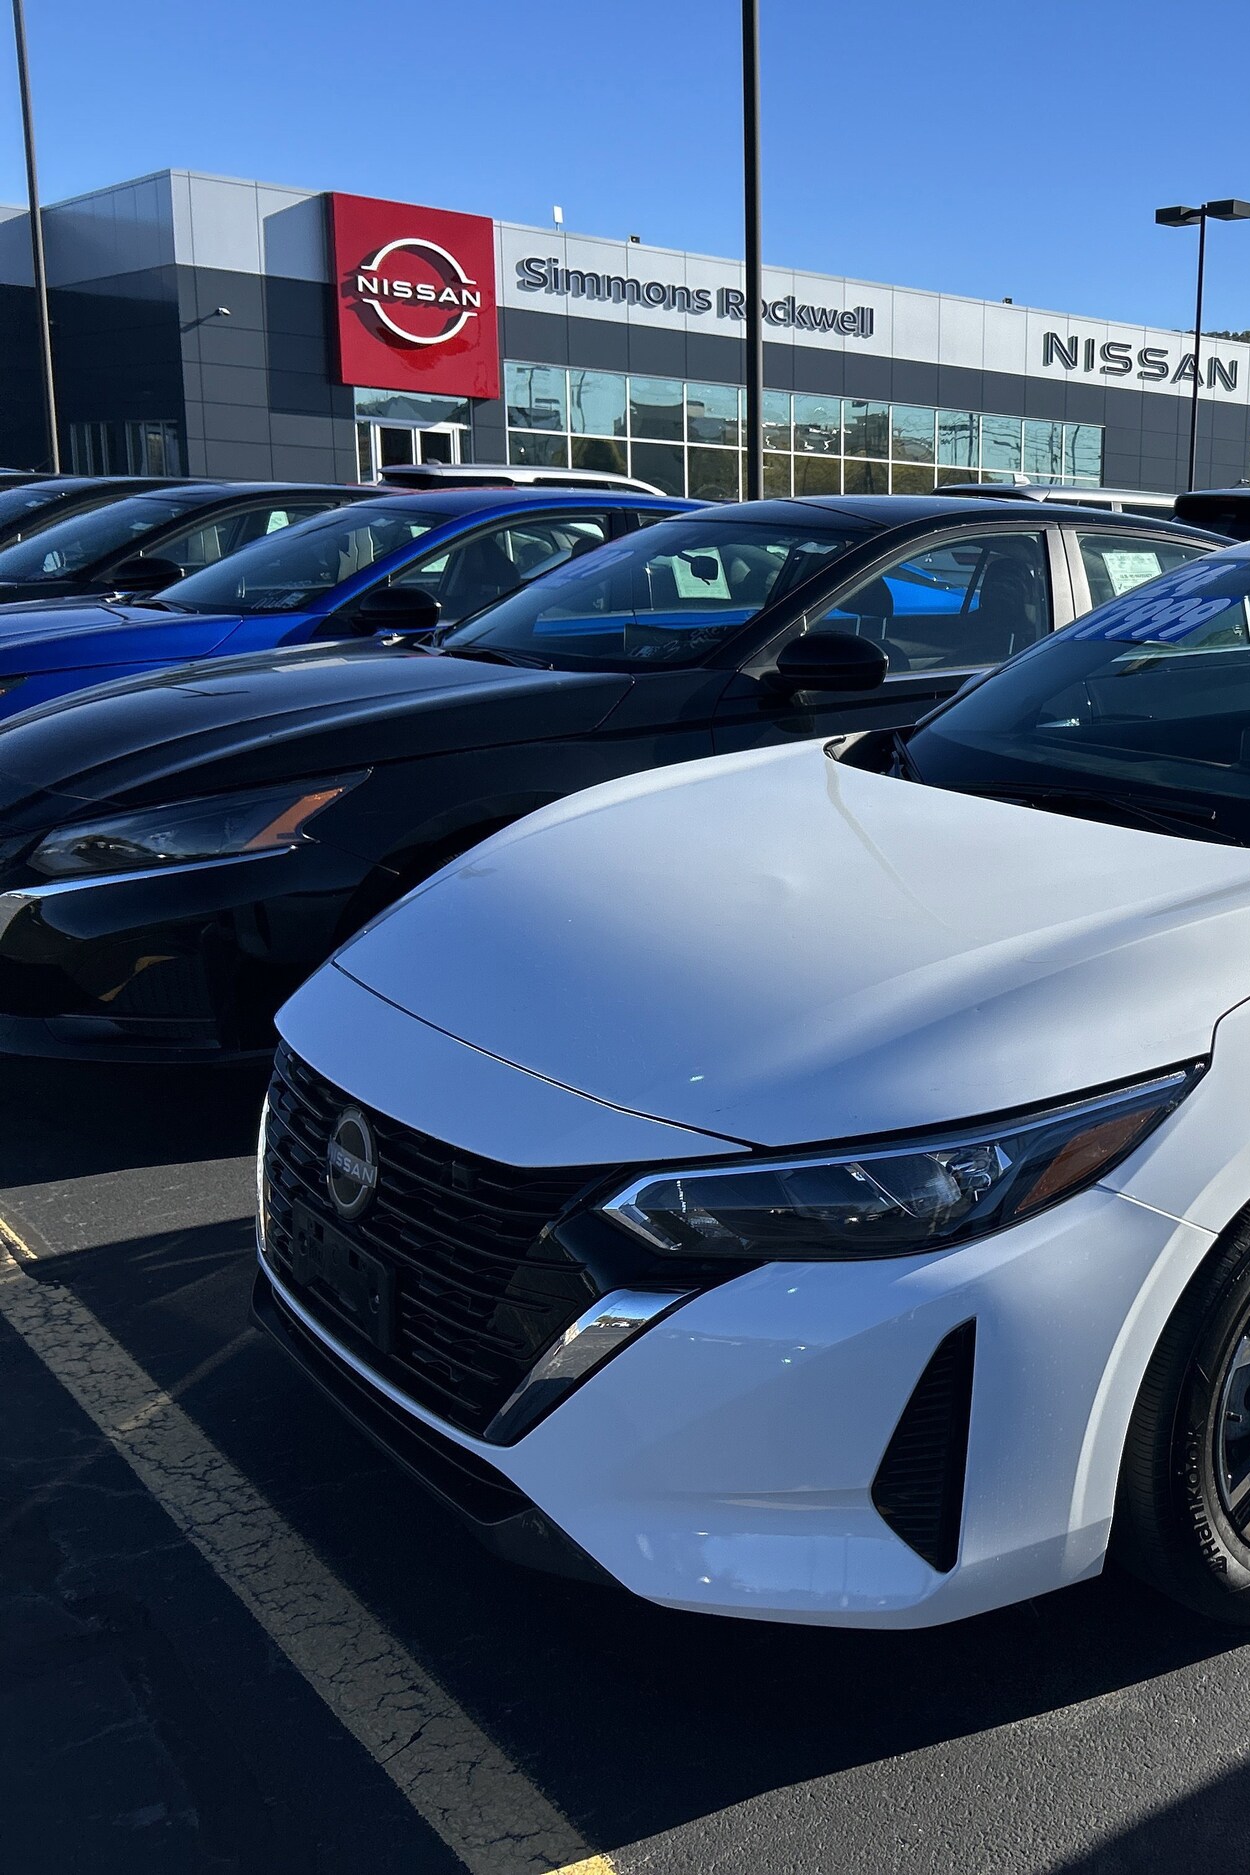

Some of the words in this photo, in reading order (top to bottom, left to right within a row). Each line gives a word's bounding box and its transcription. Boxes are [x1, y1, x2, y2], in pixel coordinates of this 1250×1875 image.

[357, 275, 481, 308] NISSAN
[518, 257, 713, 314] Simmons
[1043, 332, 1239, 392] NISSAN
[328, 1141, 374, 1184] NISSAN
